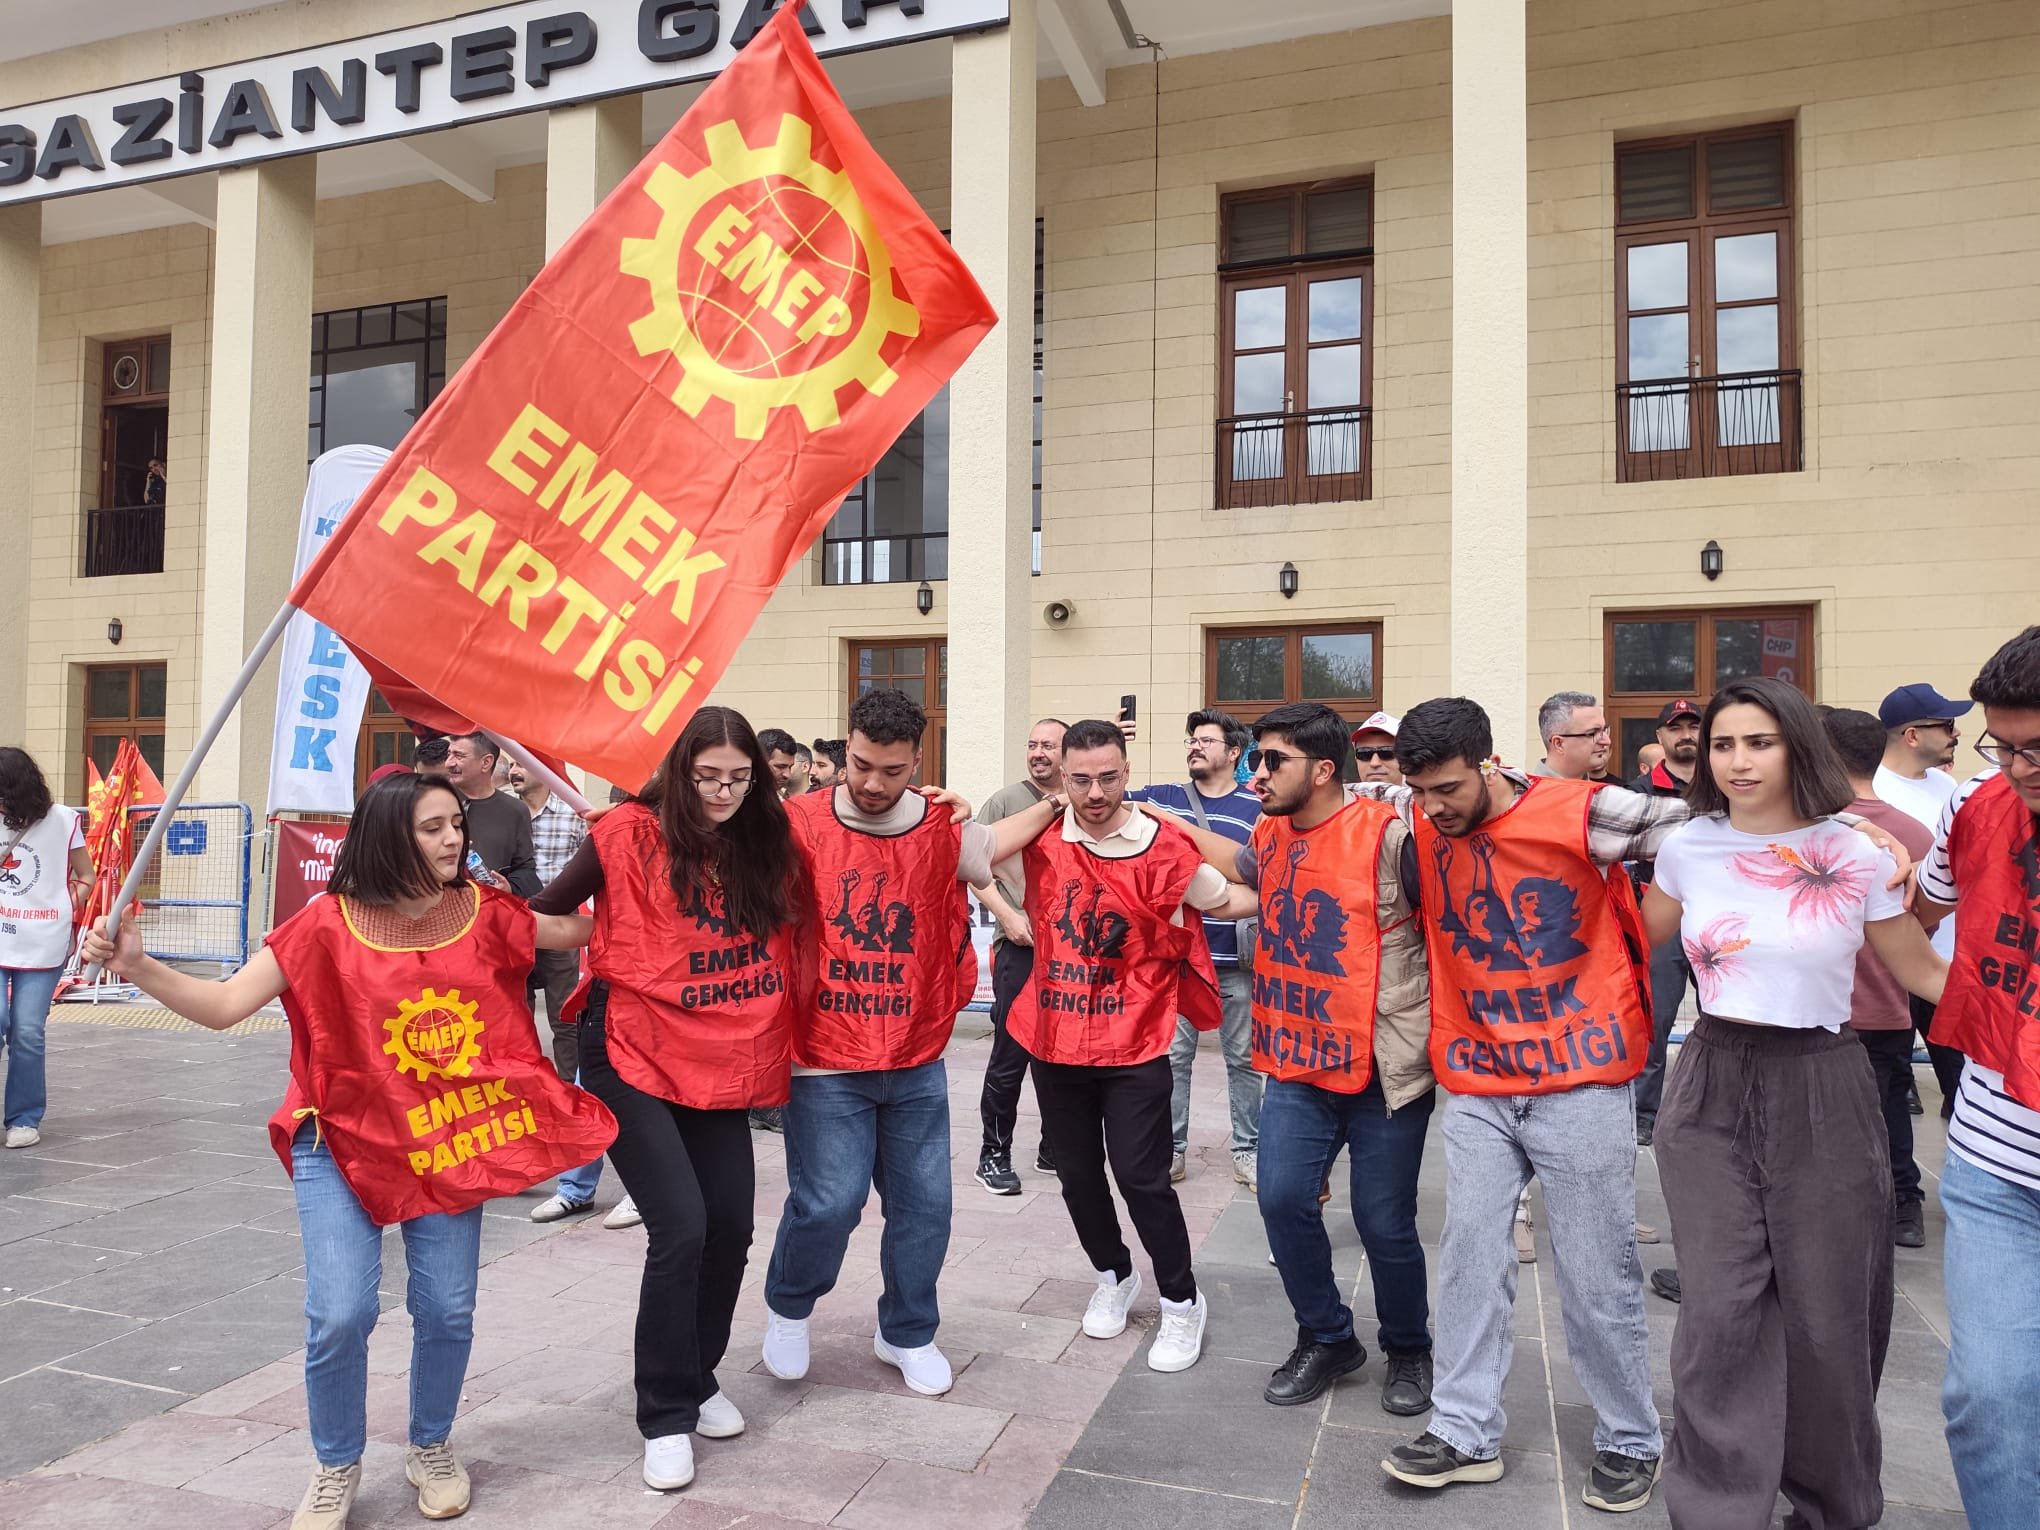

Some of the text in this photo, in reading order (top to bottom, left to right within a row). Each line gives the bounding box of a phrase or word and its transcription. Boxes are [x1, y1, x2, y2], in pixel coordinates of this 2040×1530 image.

[0, 11, 597, 186] GAZİANTEP
[693, 203, 851, 344] EMEP
[486, 402, 727, 625] EMEK
[377, 465, 703, 736] PARTİSİ
[1767, 638, 1793, 653] CHP
[290, 620, 348, 773] ESK
[681, 964, 784, 1009] GENÇLİĞİ
[689, 941, 772, 975] EMEK
[829, 959, 905, 984] EMEK
[1048, 960, 1116, 986] EMEK
[818, 988, 912, 1021] GENÇLİĞİ
[1459, 975, 1588, 1025] MEK
[406, 1022, 465, 1052] EMEP
[1252, 1016, 1352, 1074] NÇLİĞİ
[1446, 1013, 1627, 1085] GENÇLİĞİ
[406, 1077, 516, 1139] EMEK
[408, 1099, 538, 1176] PARTİSİ
